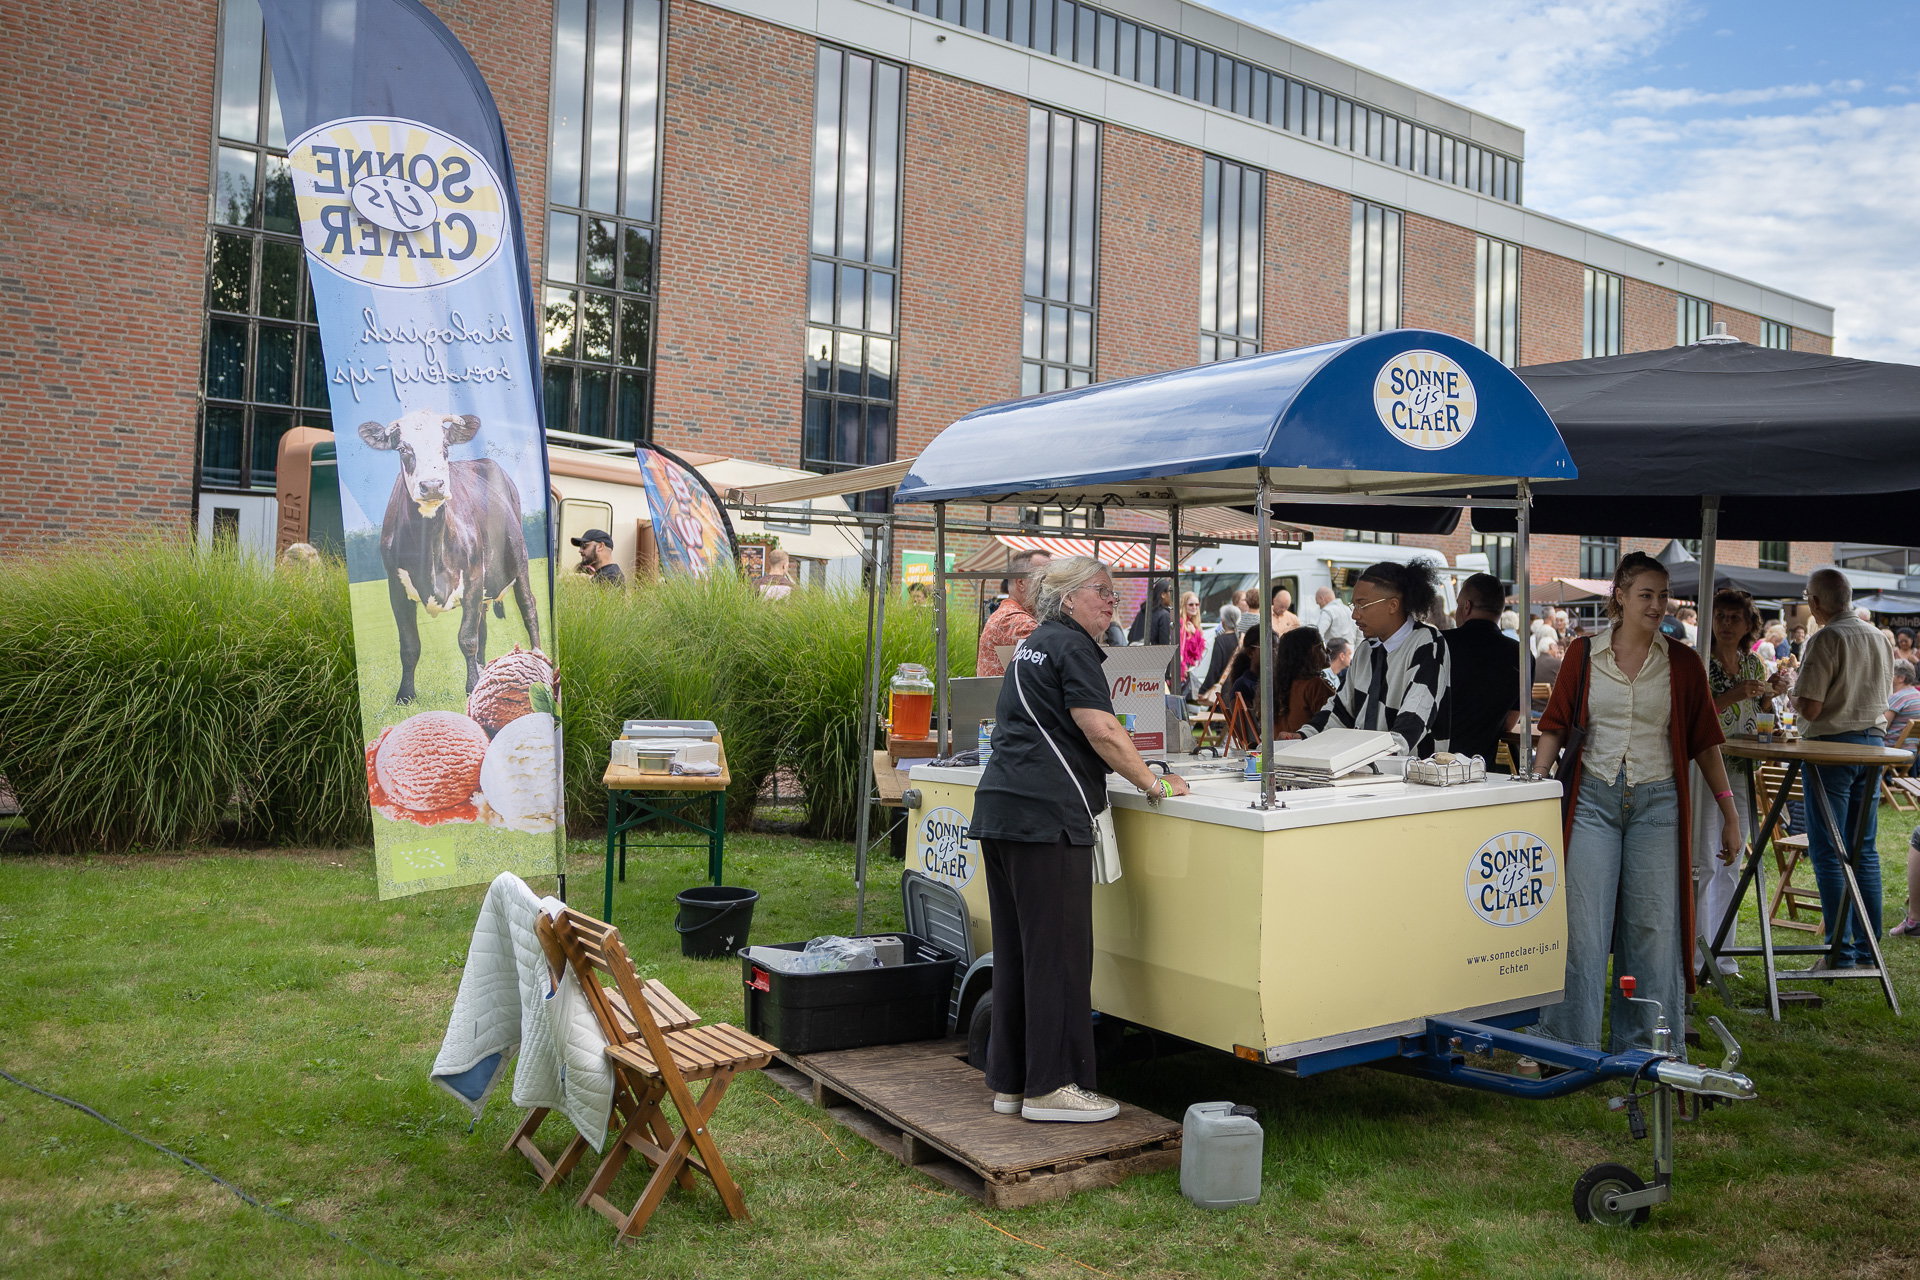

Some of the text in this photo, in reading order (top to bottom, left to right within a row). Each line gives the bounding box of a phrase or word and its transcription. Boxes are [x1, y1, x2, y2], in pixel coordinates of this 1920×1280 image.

[1391, 367, 1459, 398] SONNE
[1415, 386, 1439, 413] ijs
[1392, 401, 1461, 432] CLAER
[926, 820, 968, 850] SONNE
[939, 837, 955, 859] ijs
[925, 847, 967, 879] CLAER
[1480, 846, 1543, 879] SONNE
[1502, 864, 1526, 893] ijs
[1481, 878, 1543, 912] CLAER
[1466, 940, 1559, 965] www.sonneclaer-ijs.nl
[1499, 962, 1529, 976] Echten
